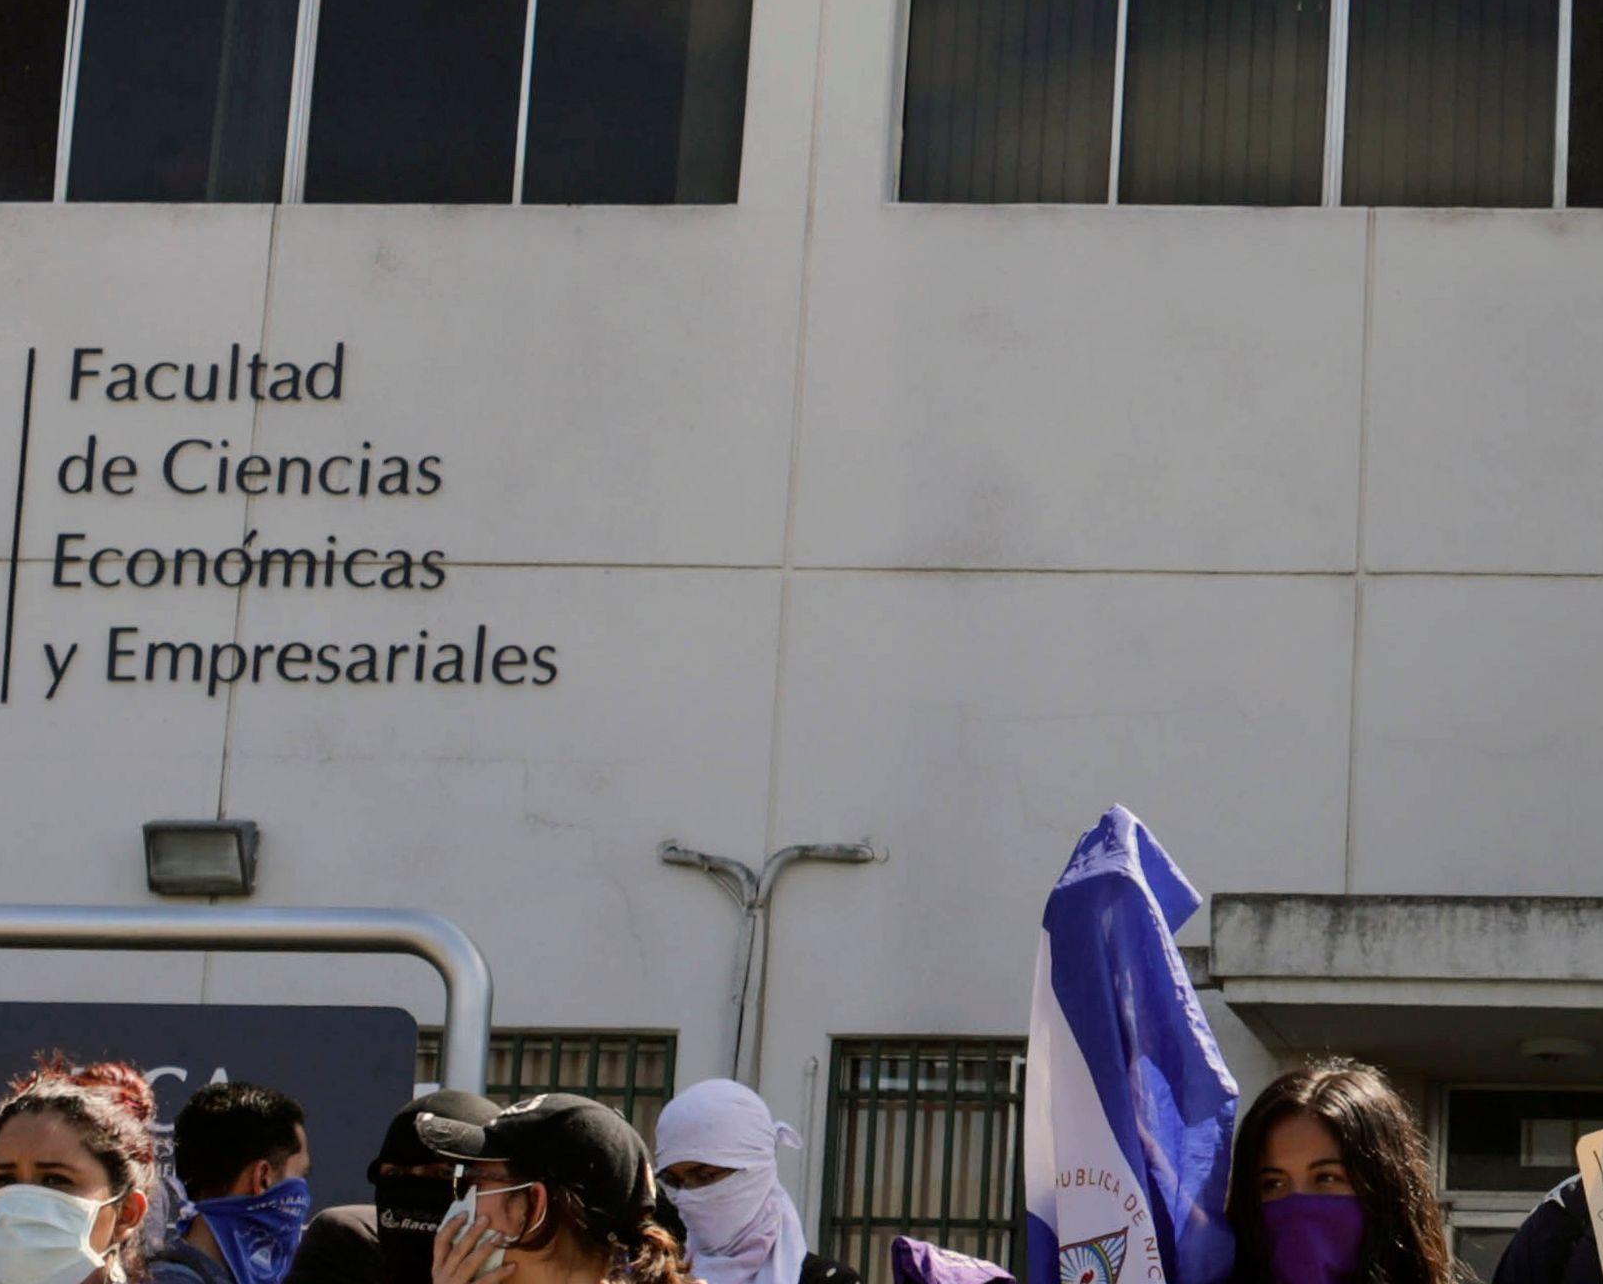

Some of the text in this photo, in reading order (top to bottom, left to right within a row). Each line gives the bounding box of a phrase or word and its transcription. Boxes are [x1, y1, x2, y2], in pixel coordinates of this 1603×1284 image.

[68, 341, 347, 405] Facultad
[57, 436, 443, 499] de Ciencias
[51, 528, 448, 592] Económicas
[43, 622, 560, 696] y Empresariales
[1056, 1167, 1121, 1196] UBLICA
[1123, 1193, 1148, 1228] DE
